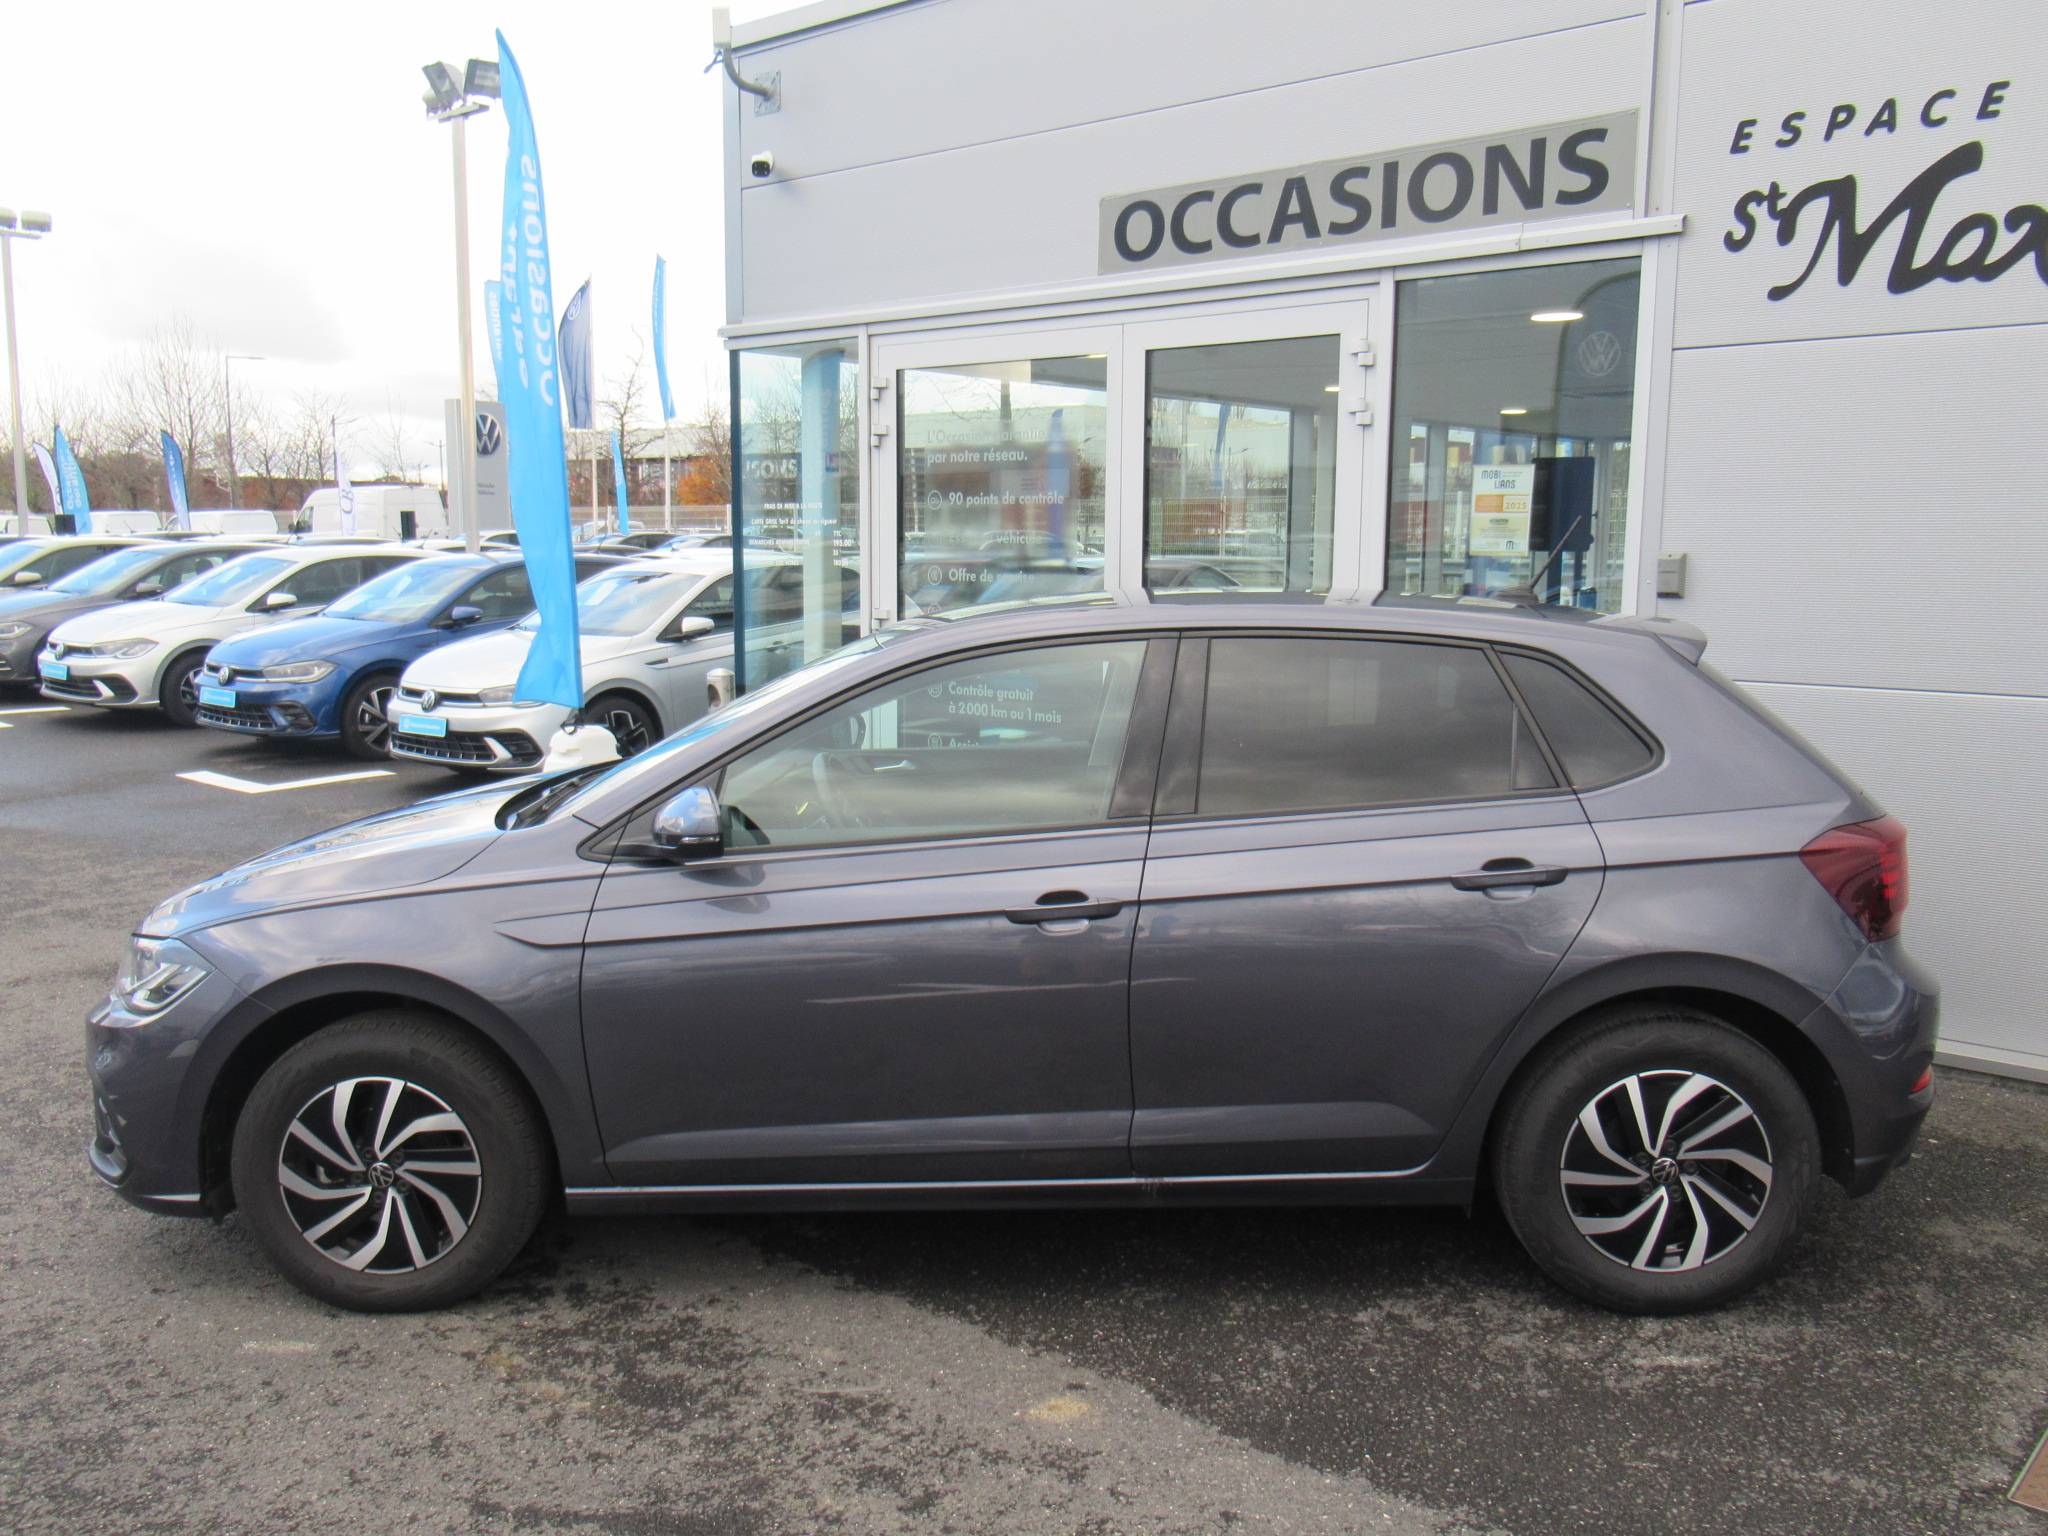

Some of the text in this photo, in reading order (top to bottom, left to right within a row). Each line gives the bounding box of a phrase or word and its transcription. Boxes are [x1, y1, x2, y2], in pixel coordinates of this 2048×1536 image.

[1729, 80, 2011, 154] ESPACE
[1114, 128, 1610, 262] OCCASIONS
[928, 447, 1028, 465] par notre réseau.
[948, 488, 1065, 508] 90 points de contrôle
[948, 568, 977, 582] Offre
[979, 569, 994, 582] de
[948, 681, 1034, 702] Contrôle gratuit
[948, 702, 956, 713] à
[991, 704, 1007, 719] km
[1010, 710, 1024, 720] ou
[1035, 710, 1062, 724] mois
